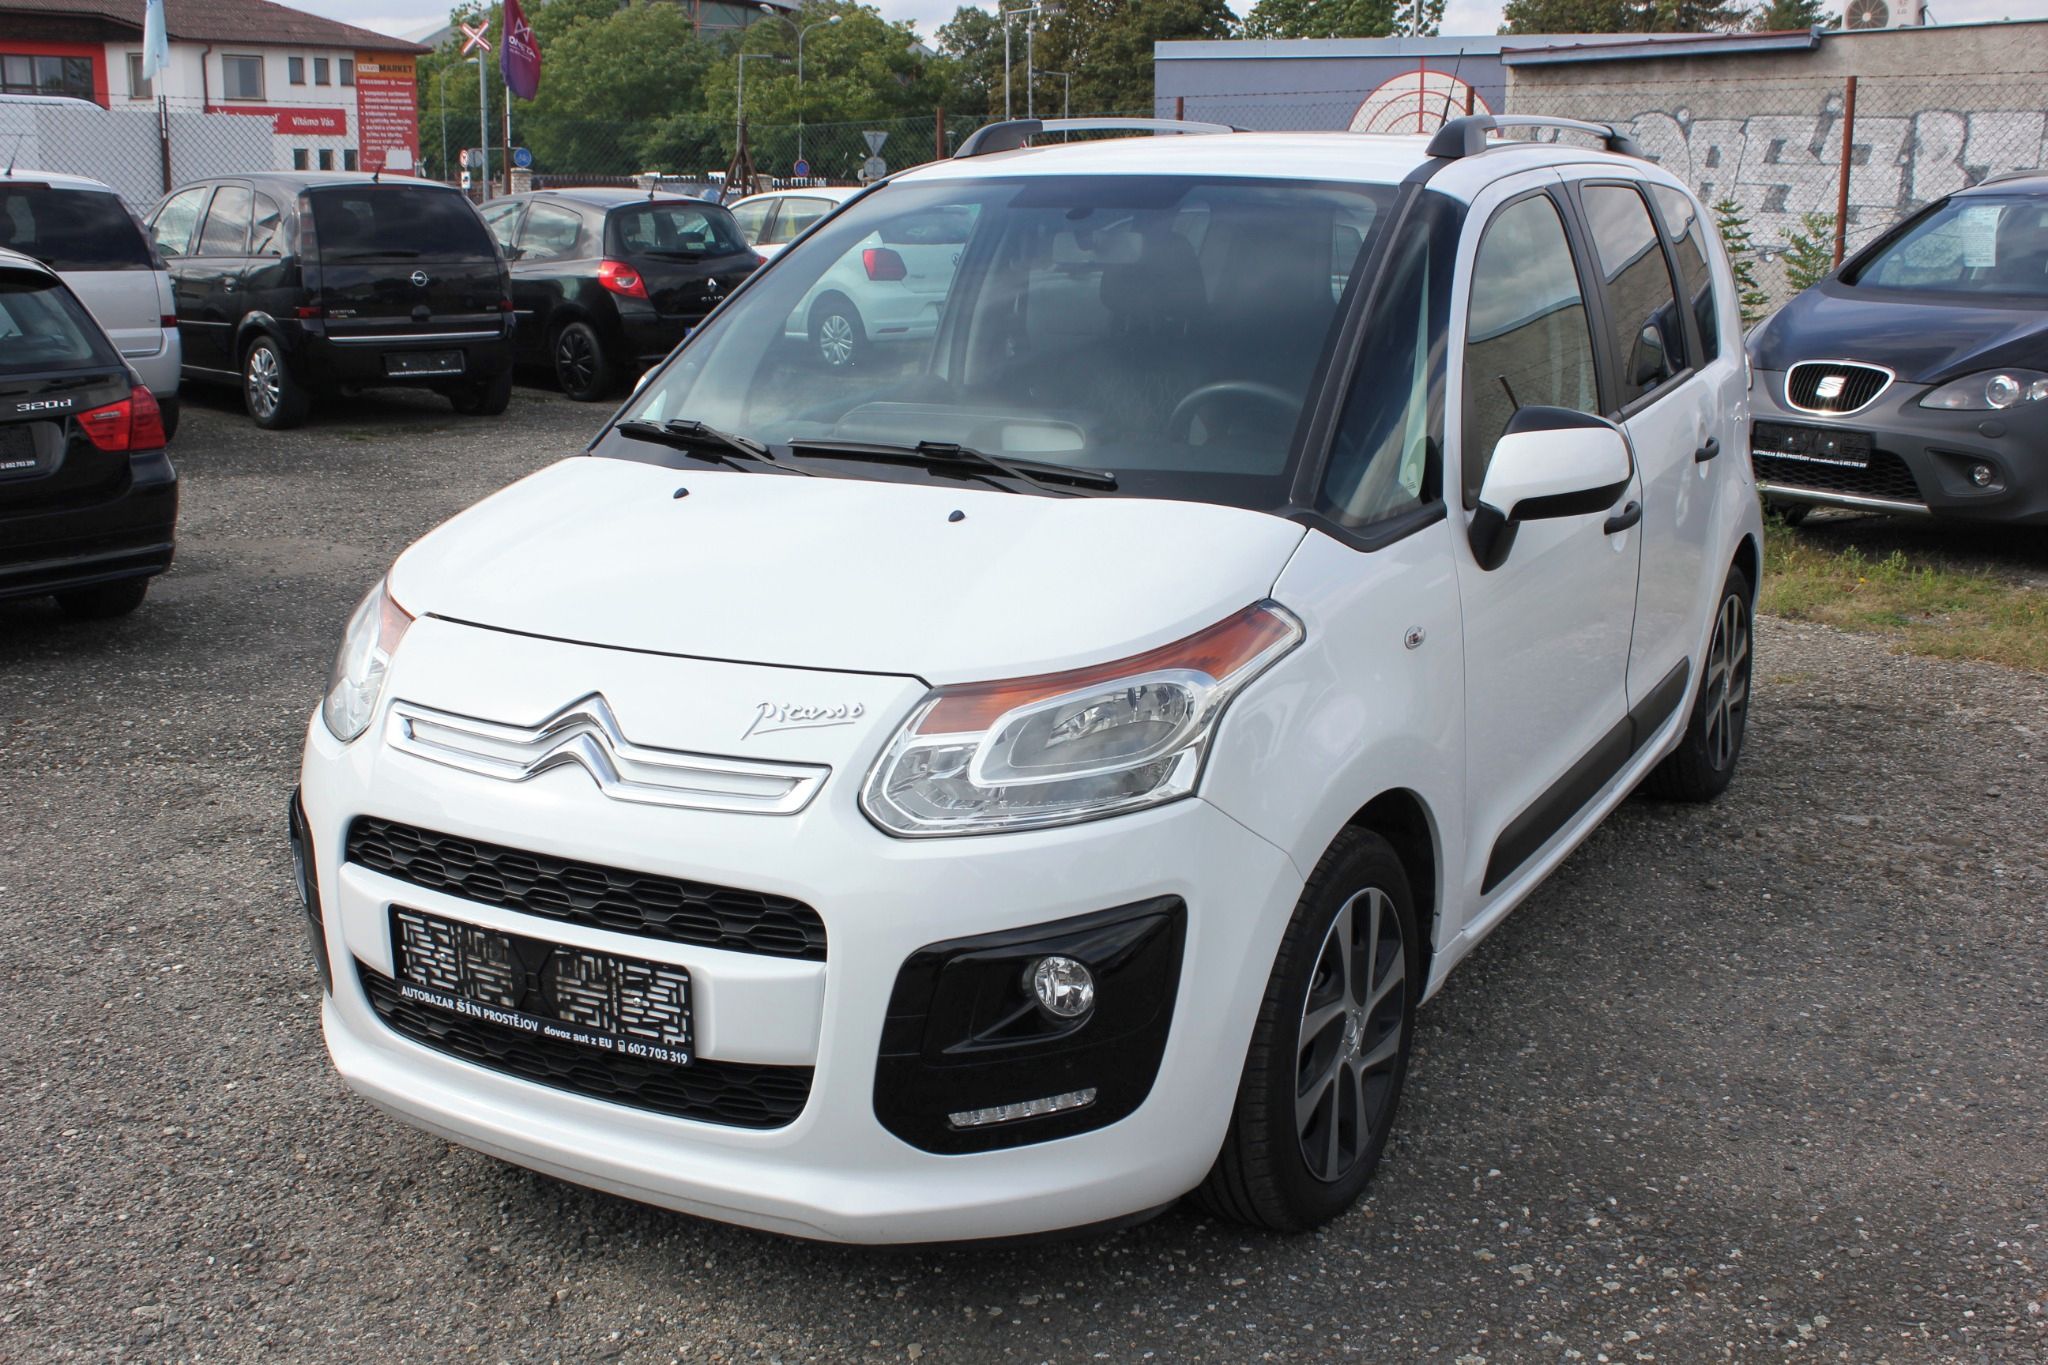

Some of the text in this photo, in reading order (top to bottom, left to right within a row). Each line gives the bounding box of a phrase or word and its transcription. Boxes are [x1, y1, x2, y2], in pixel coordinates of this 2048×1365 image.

[16, 398, 72, 412] 320d
[740, 702, 864, 740] Picasso
[401, 985, 688, 1064] AUTOBAZAR ŠÍN PROSTĚJOV dovoz aut z EU 602 703 319
